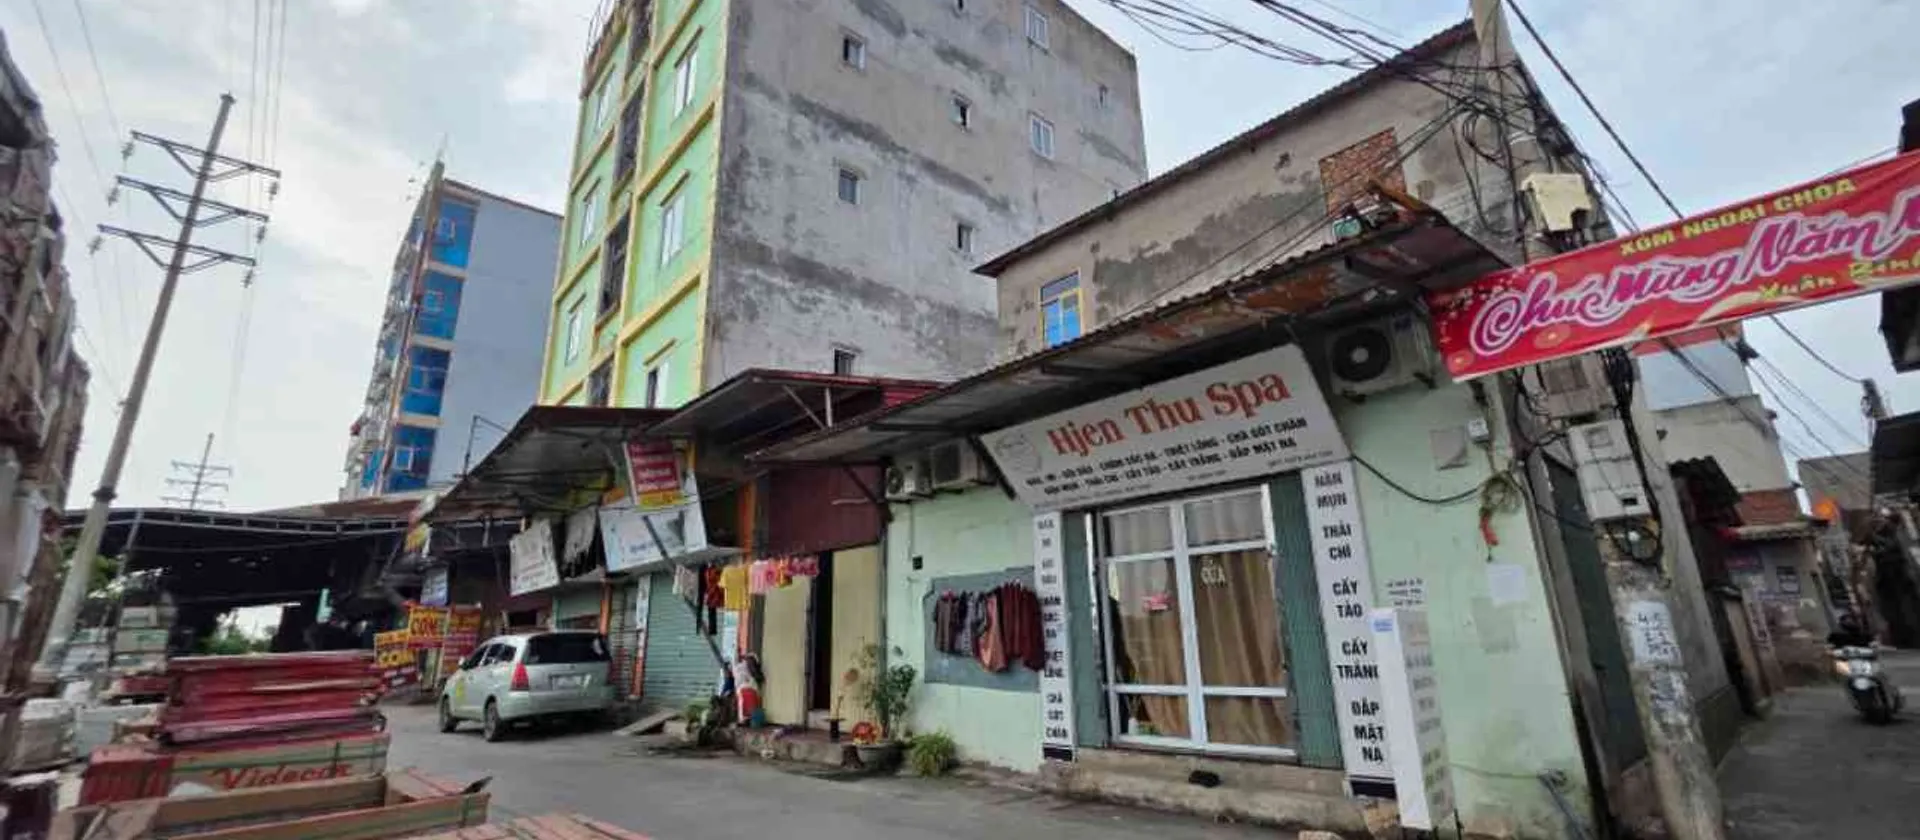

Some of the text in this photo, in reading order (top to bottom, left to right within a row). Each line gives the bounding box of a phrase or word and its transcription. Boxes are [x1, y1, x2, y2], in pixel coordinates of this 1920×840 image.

[1469, 271, 1625, 356] Chúc
[1740, 211, 1892, 284] Năm
[1124, 396, 1206, 435] Thu
[1205, 373, 1292, 418] Spa
